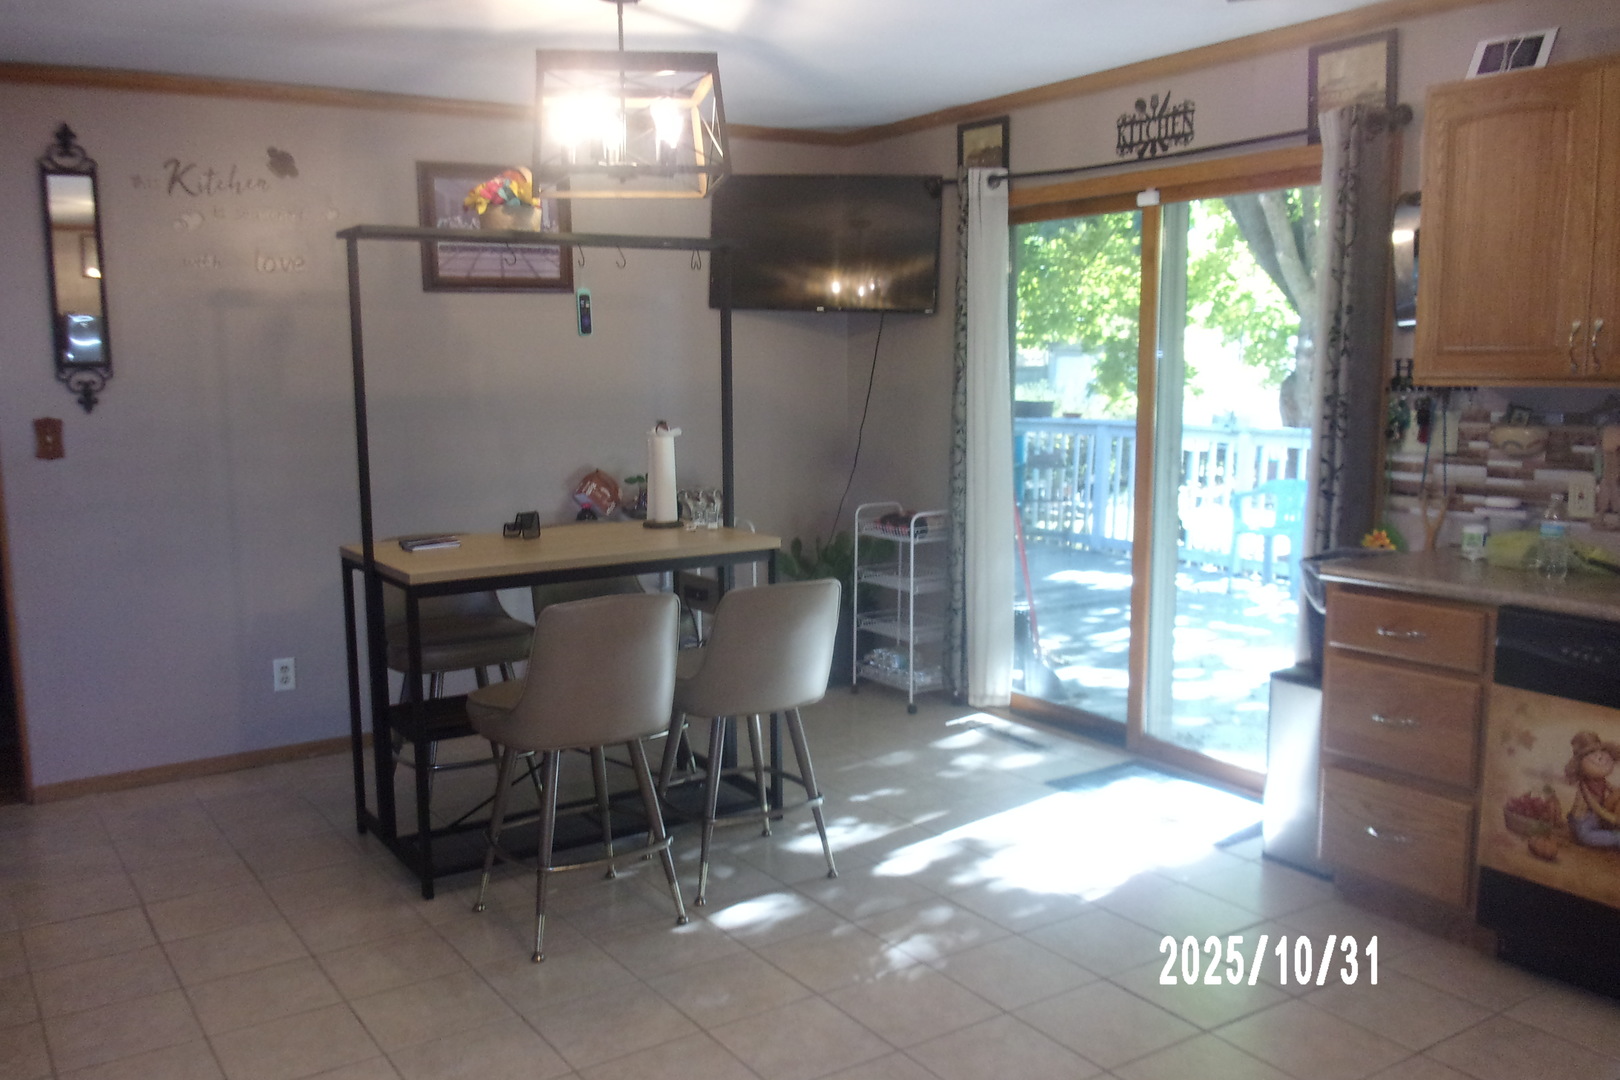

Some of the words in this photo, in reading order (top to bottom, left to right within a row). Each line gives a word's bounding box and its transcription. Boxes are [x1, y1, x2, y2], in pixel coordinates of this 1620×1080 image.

[1117, 109, 1195, 149] KITCHEN
[163, 158, 270, 197] Kitchen
[254, 248, 305, 273] love
